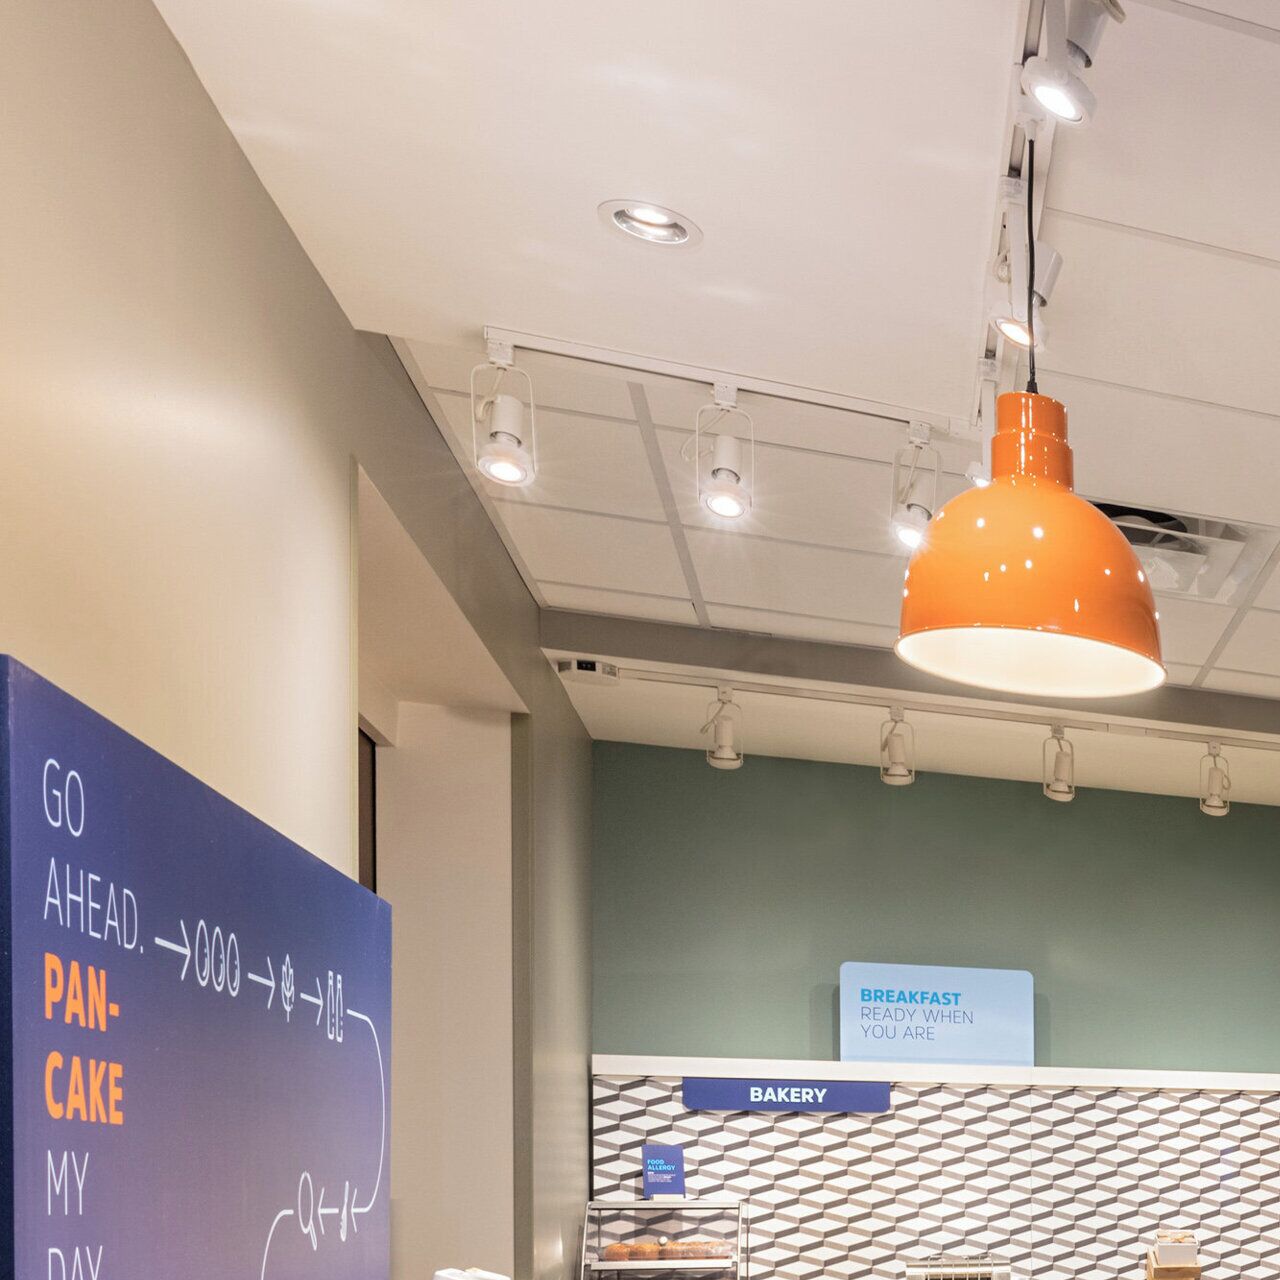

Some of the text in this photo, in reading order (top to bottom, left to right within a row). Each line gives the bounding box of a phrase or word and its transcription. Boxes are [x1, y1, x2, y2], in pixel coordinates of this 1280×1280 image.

[42, 758, 86, 838] GO
[43, 857, 144, 954] AHEAD.
[44, 952, 120, 1032] PAN-
[860, 988, 962, 1006] BREAKFAST
[860, 1006, 974, 1024] READY WHEN
[860, 1024, 935, 1041] YOU ARE
[44, 1051, 125, 1126] CAKE
[750, 1086, 827, 1103] BAKERY
[47, 1149, 90, 1217] MY
